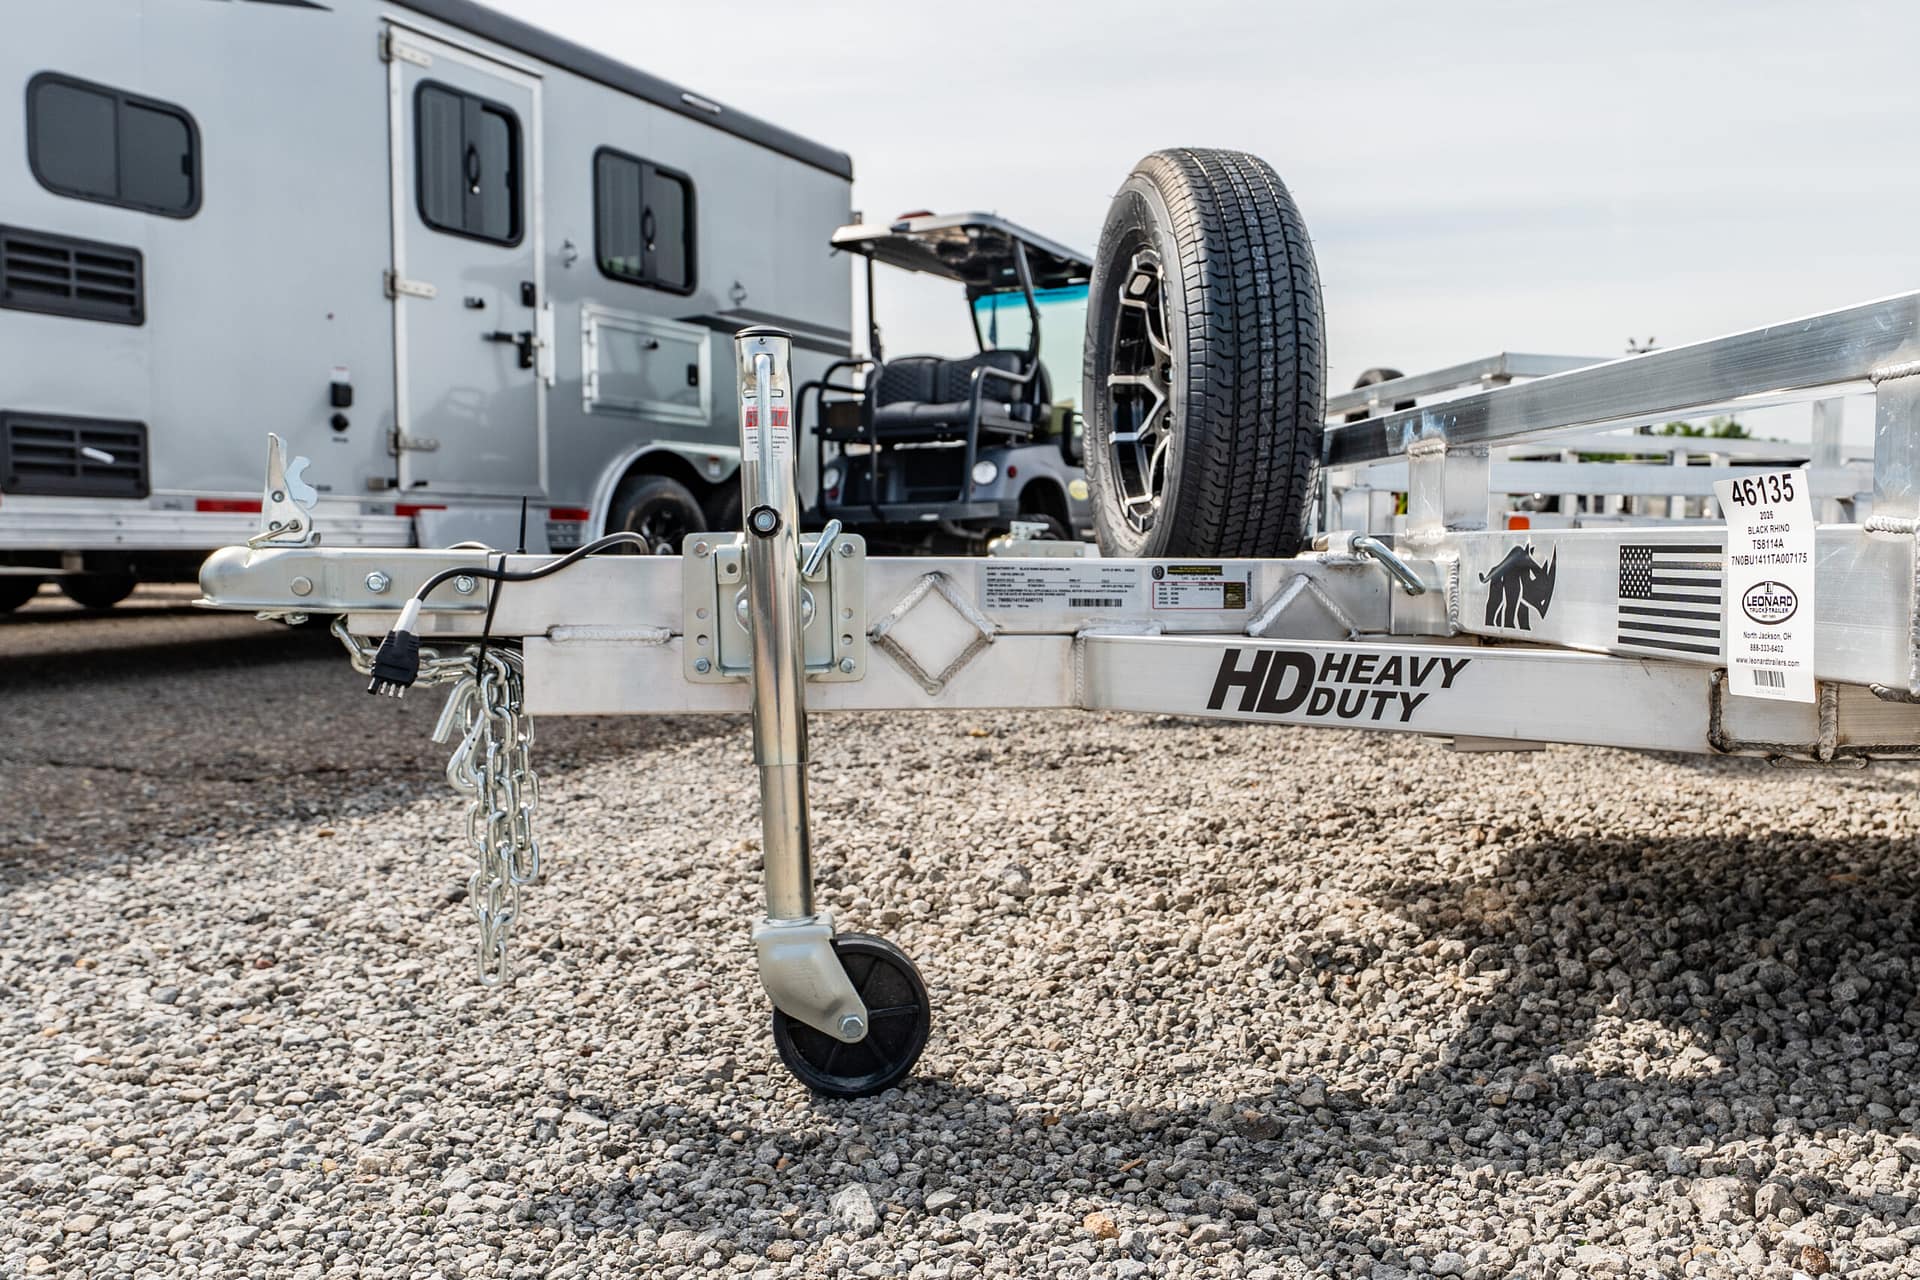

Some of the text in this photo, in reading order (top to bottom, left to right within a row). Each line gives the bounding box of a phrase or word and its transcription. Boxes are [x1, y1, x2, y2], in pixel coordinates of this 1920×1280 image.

[1732, 473, 1794, 507] 46135
[1747, 523, 1790, 535] BLACK RHINO
[1752, 538, 1785, 550] TS8114A
[1746, 595, 1793, 607] LEONARD
[1743, 631, 1758, 639] North
[1782, 632, 1793, 640] OH
[1735, 657, 1800, 667] www.leonardtrailers.com
[1317, 653, 1472, 689] HEAVY
[1206, 648, 1316, 714] HD
[1306, 687, 1429, 722] DUTY
